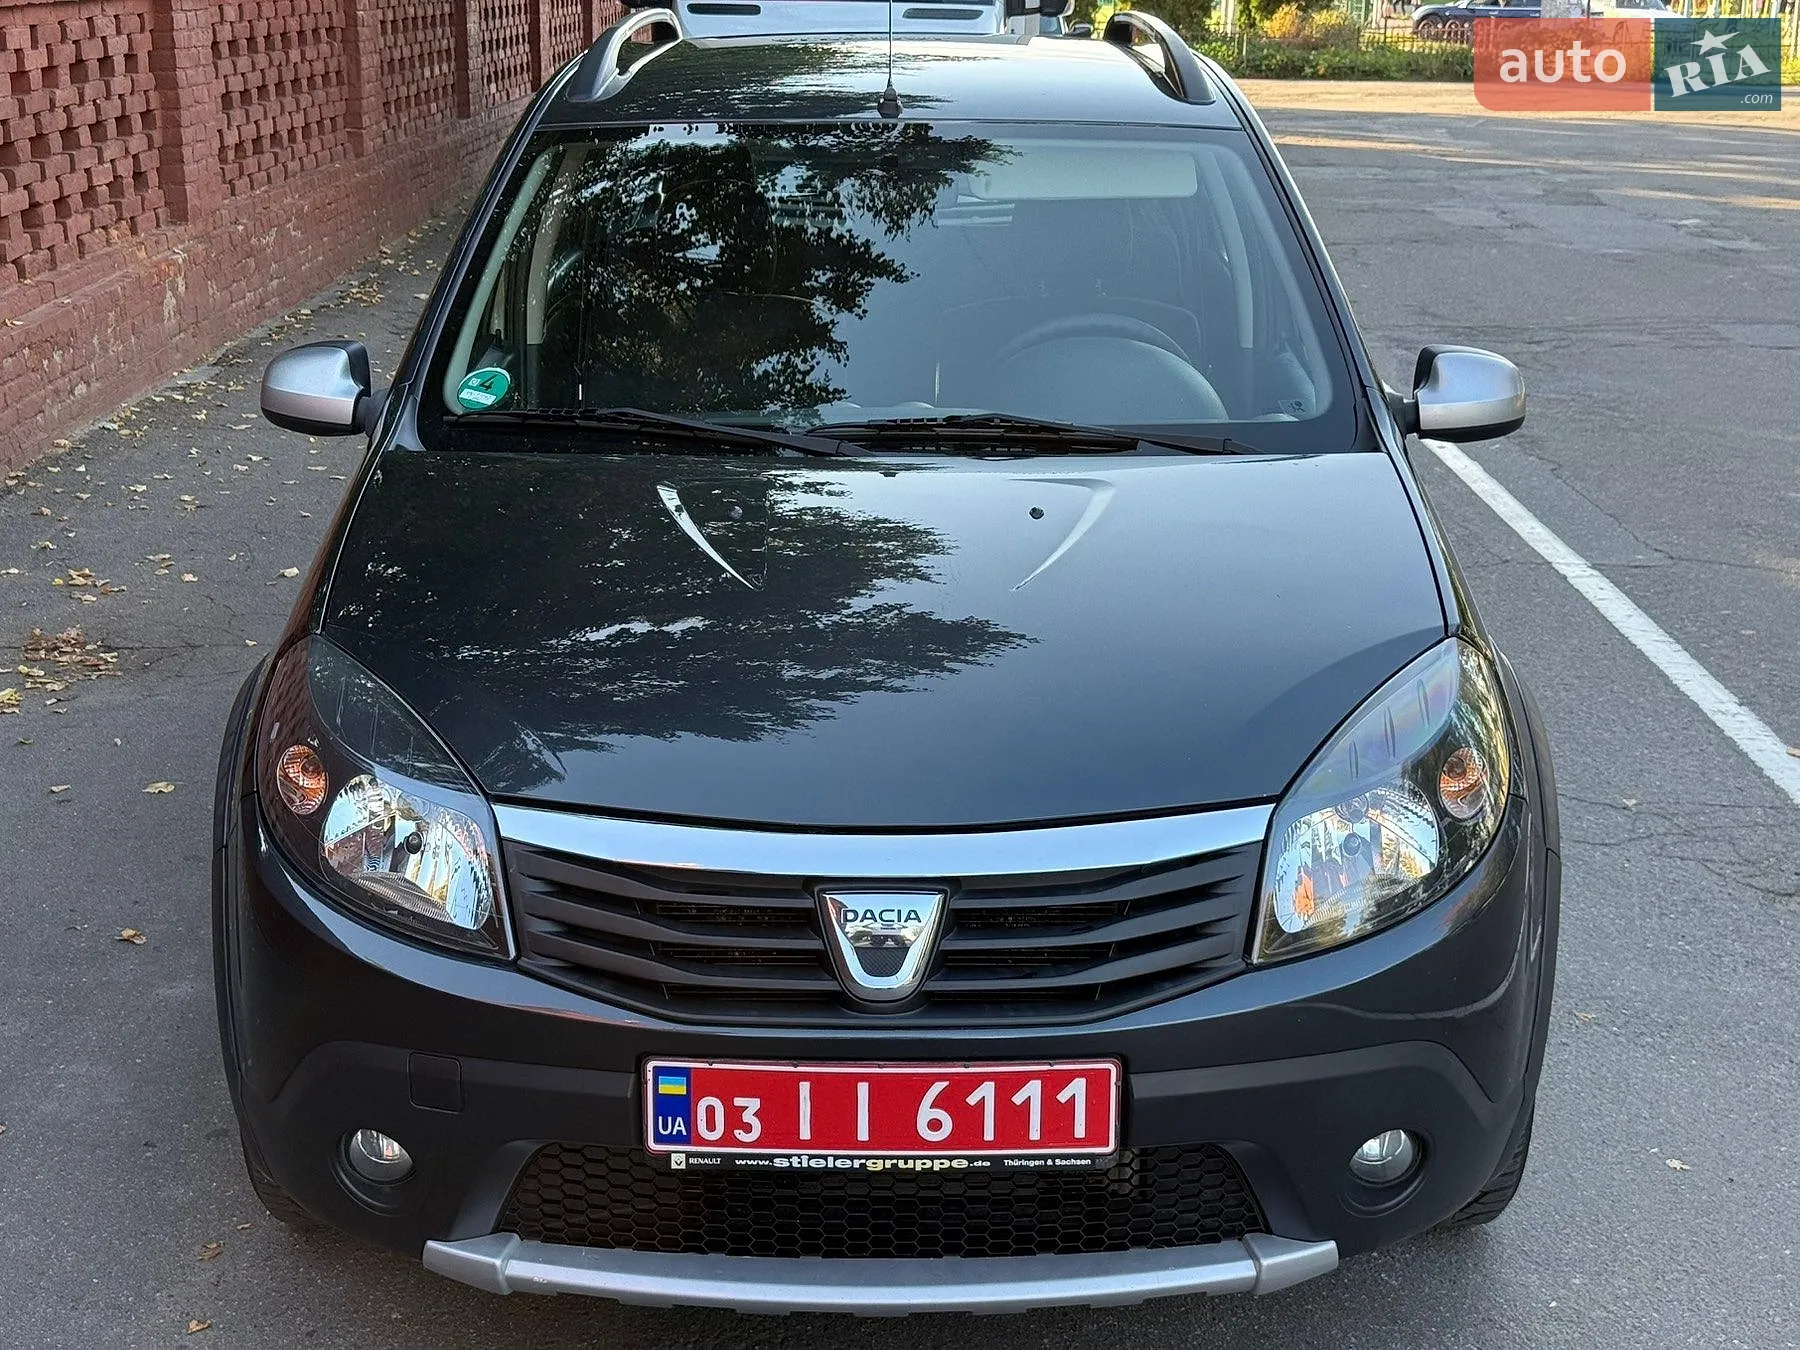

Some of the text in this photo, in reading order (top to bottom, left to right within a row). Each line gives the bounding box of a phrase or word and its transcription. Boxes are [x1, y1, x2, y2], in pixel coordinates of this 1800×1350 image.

[842, 909, 921, 923] DACIA
[697, 1097, 761, 1142] 03
[916, 1078, 1086, 1142] 6111
[659, 1116, 687, 1136] UA
[688, 1157, 722, 1165] RENAULT
[735, 1155, 991, 1171] www.stielergruppe.de
[1003, 1159, 1044, 1167] Thüringen
[1055, 1158, 1091, 1166] Sachsen
